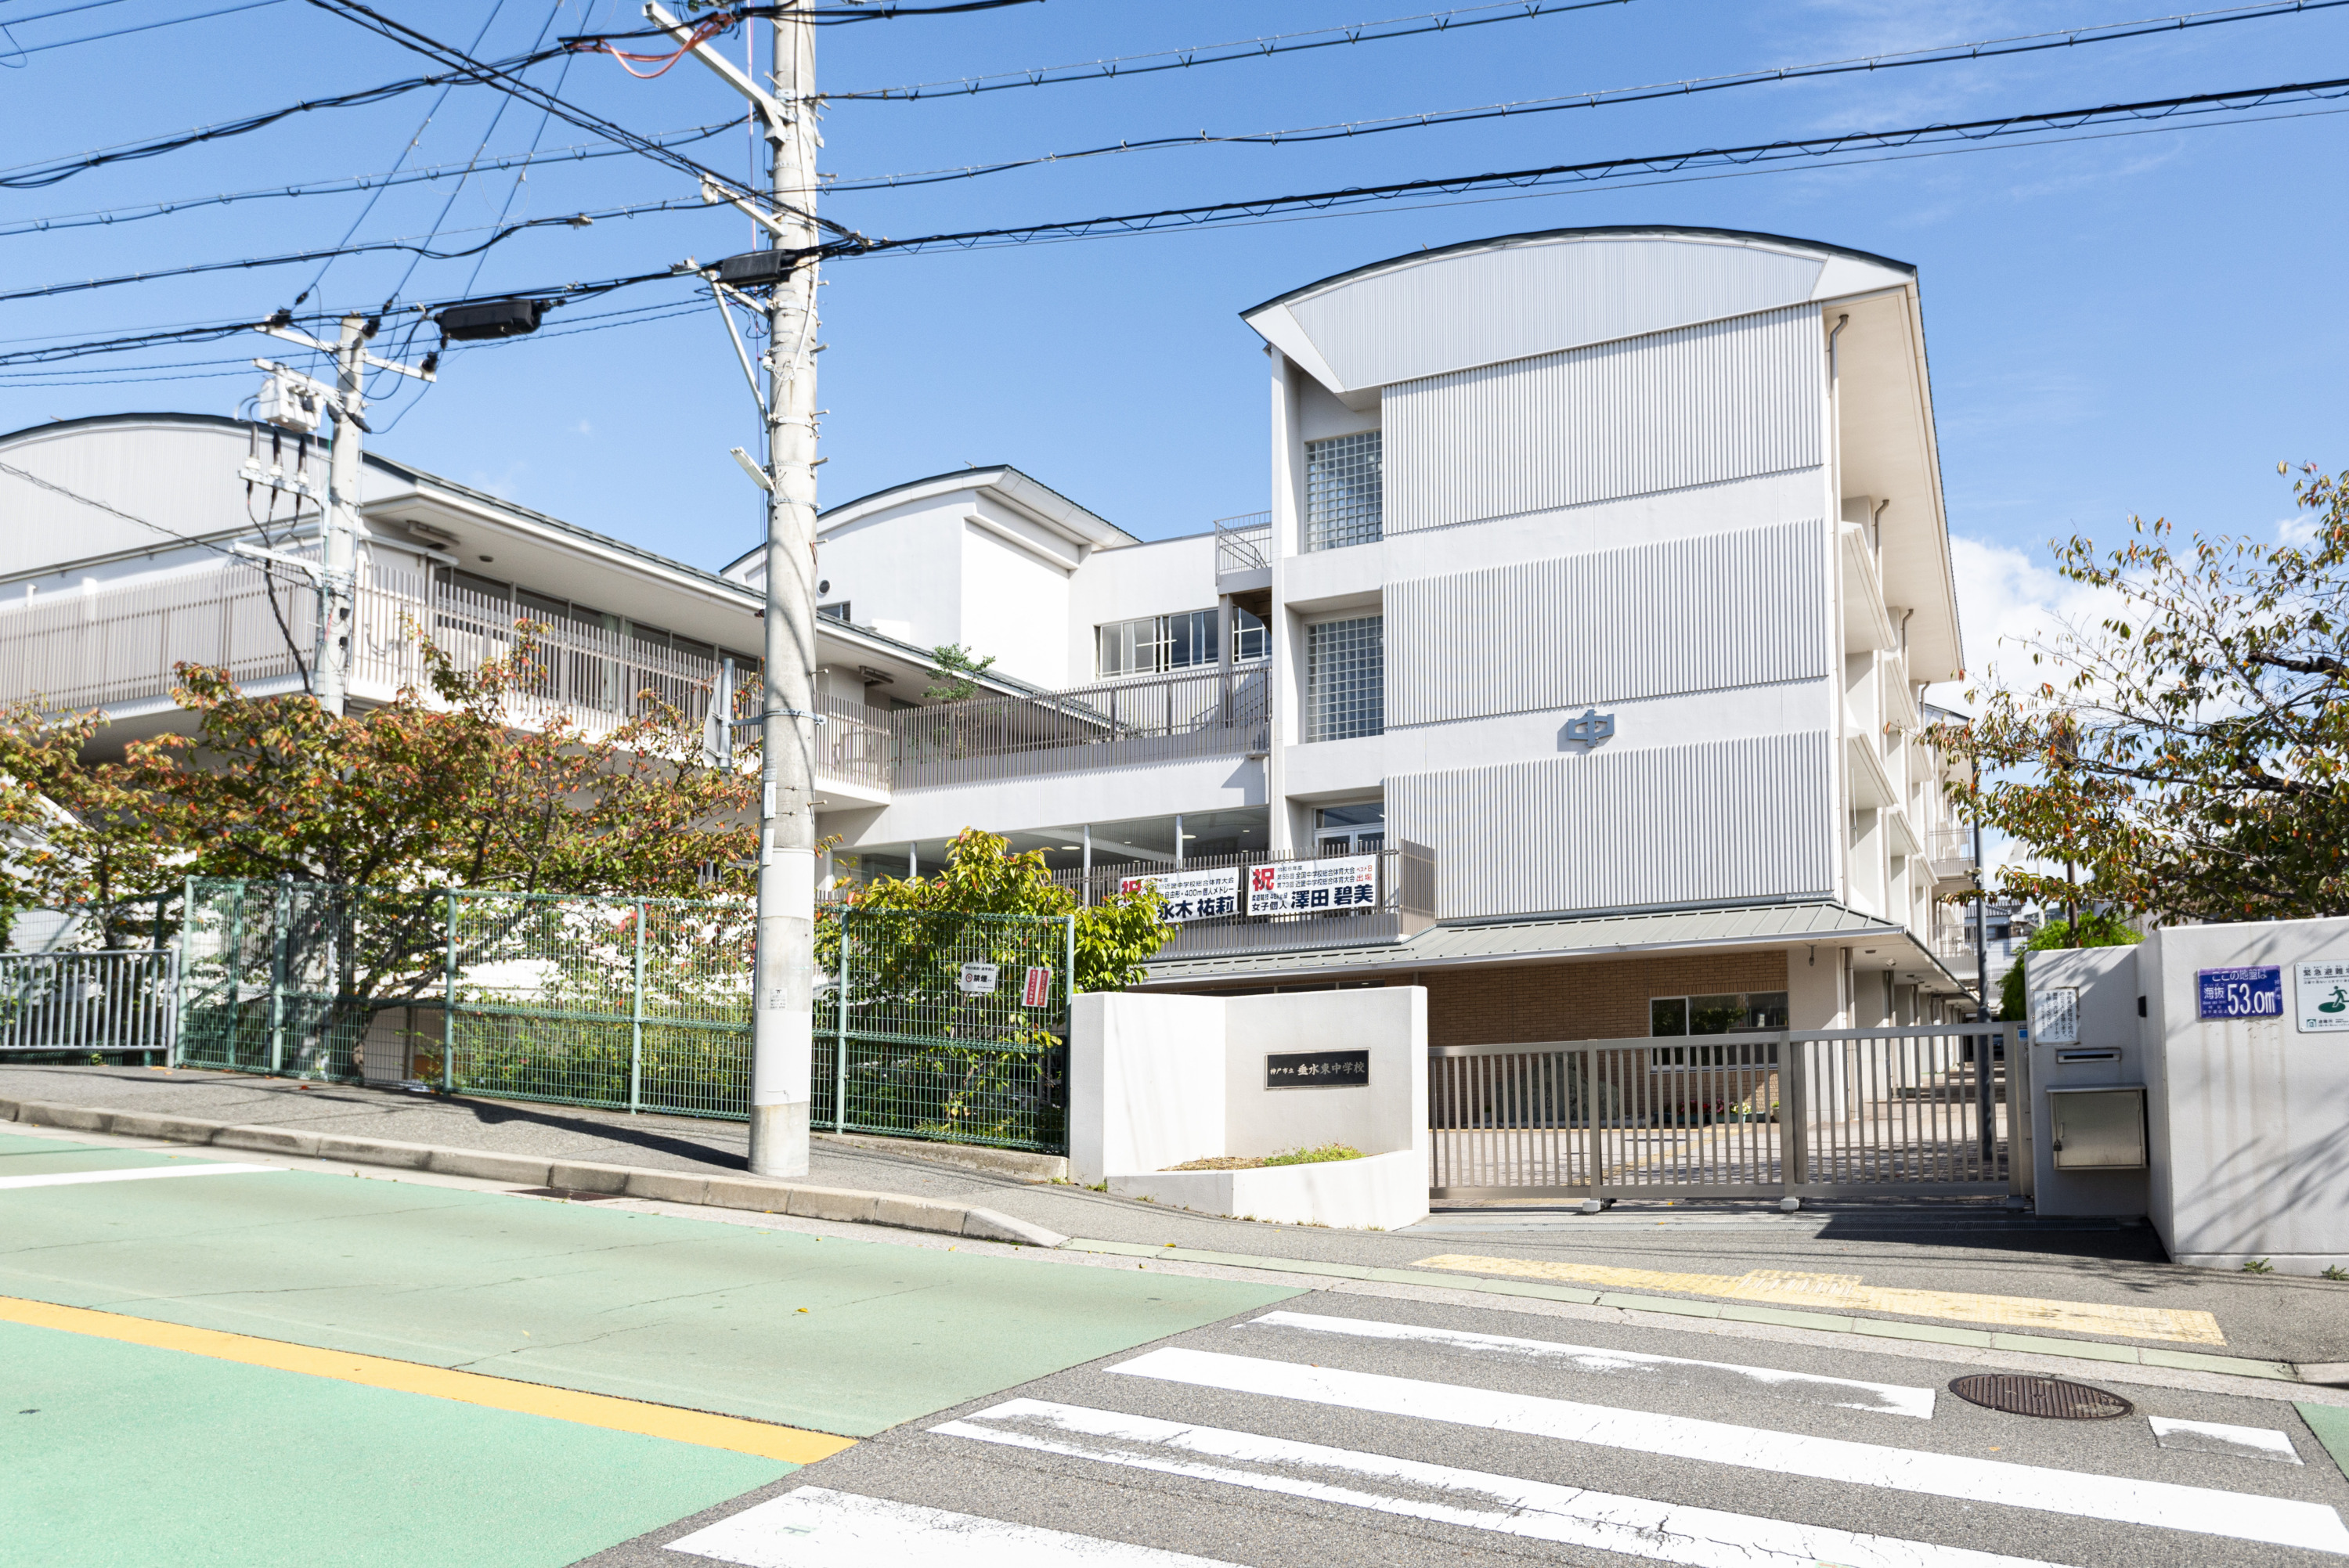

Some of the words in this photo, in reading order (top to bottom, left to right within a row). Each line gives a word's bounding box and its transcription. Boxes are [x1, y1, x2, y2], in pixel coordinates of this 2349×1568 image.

[1252, 867, 1275, 892] 祝
[1356, 873, 1373, 882] 出場
[1291, 889, 1329, 909] 澤田
[1333, 884, 1374, 907] 碧美
[1197, 896, 1235, 917] 祐莉
[1251, 900, 1287, 912] 女子個人
[2212, 968, 2268, 982] ここの地盤は
[2203, 986, 2225, 1000] 海抜
[2227, 982, 2276, 1015] 53.0m
[1297, 1061, 1365, 1076] 垂水東中学校
